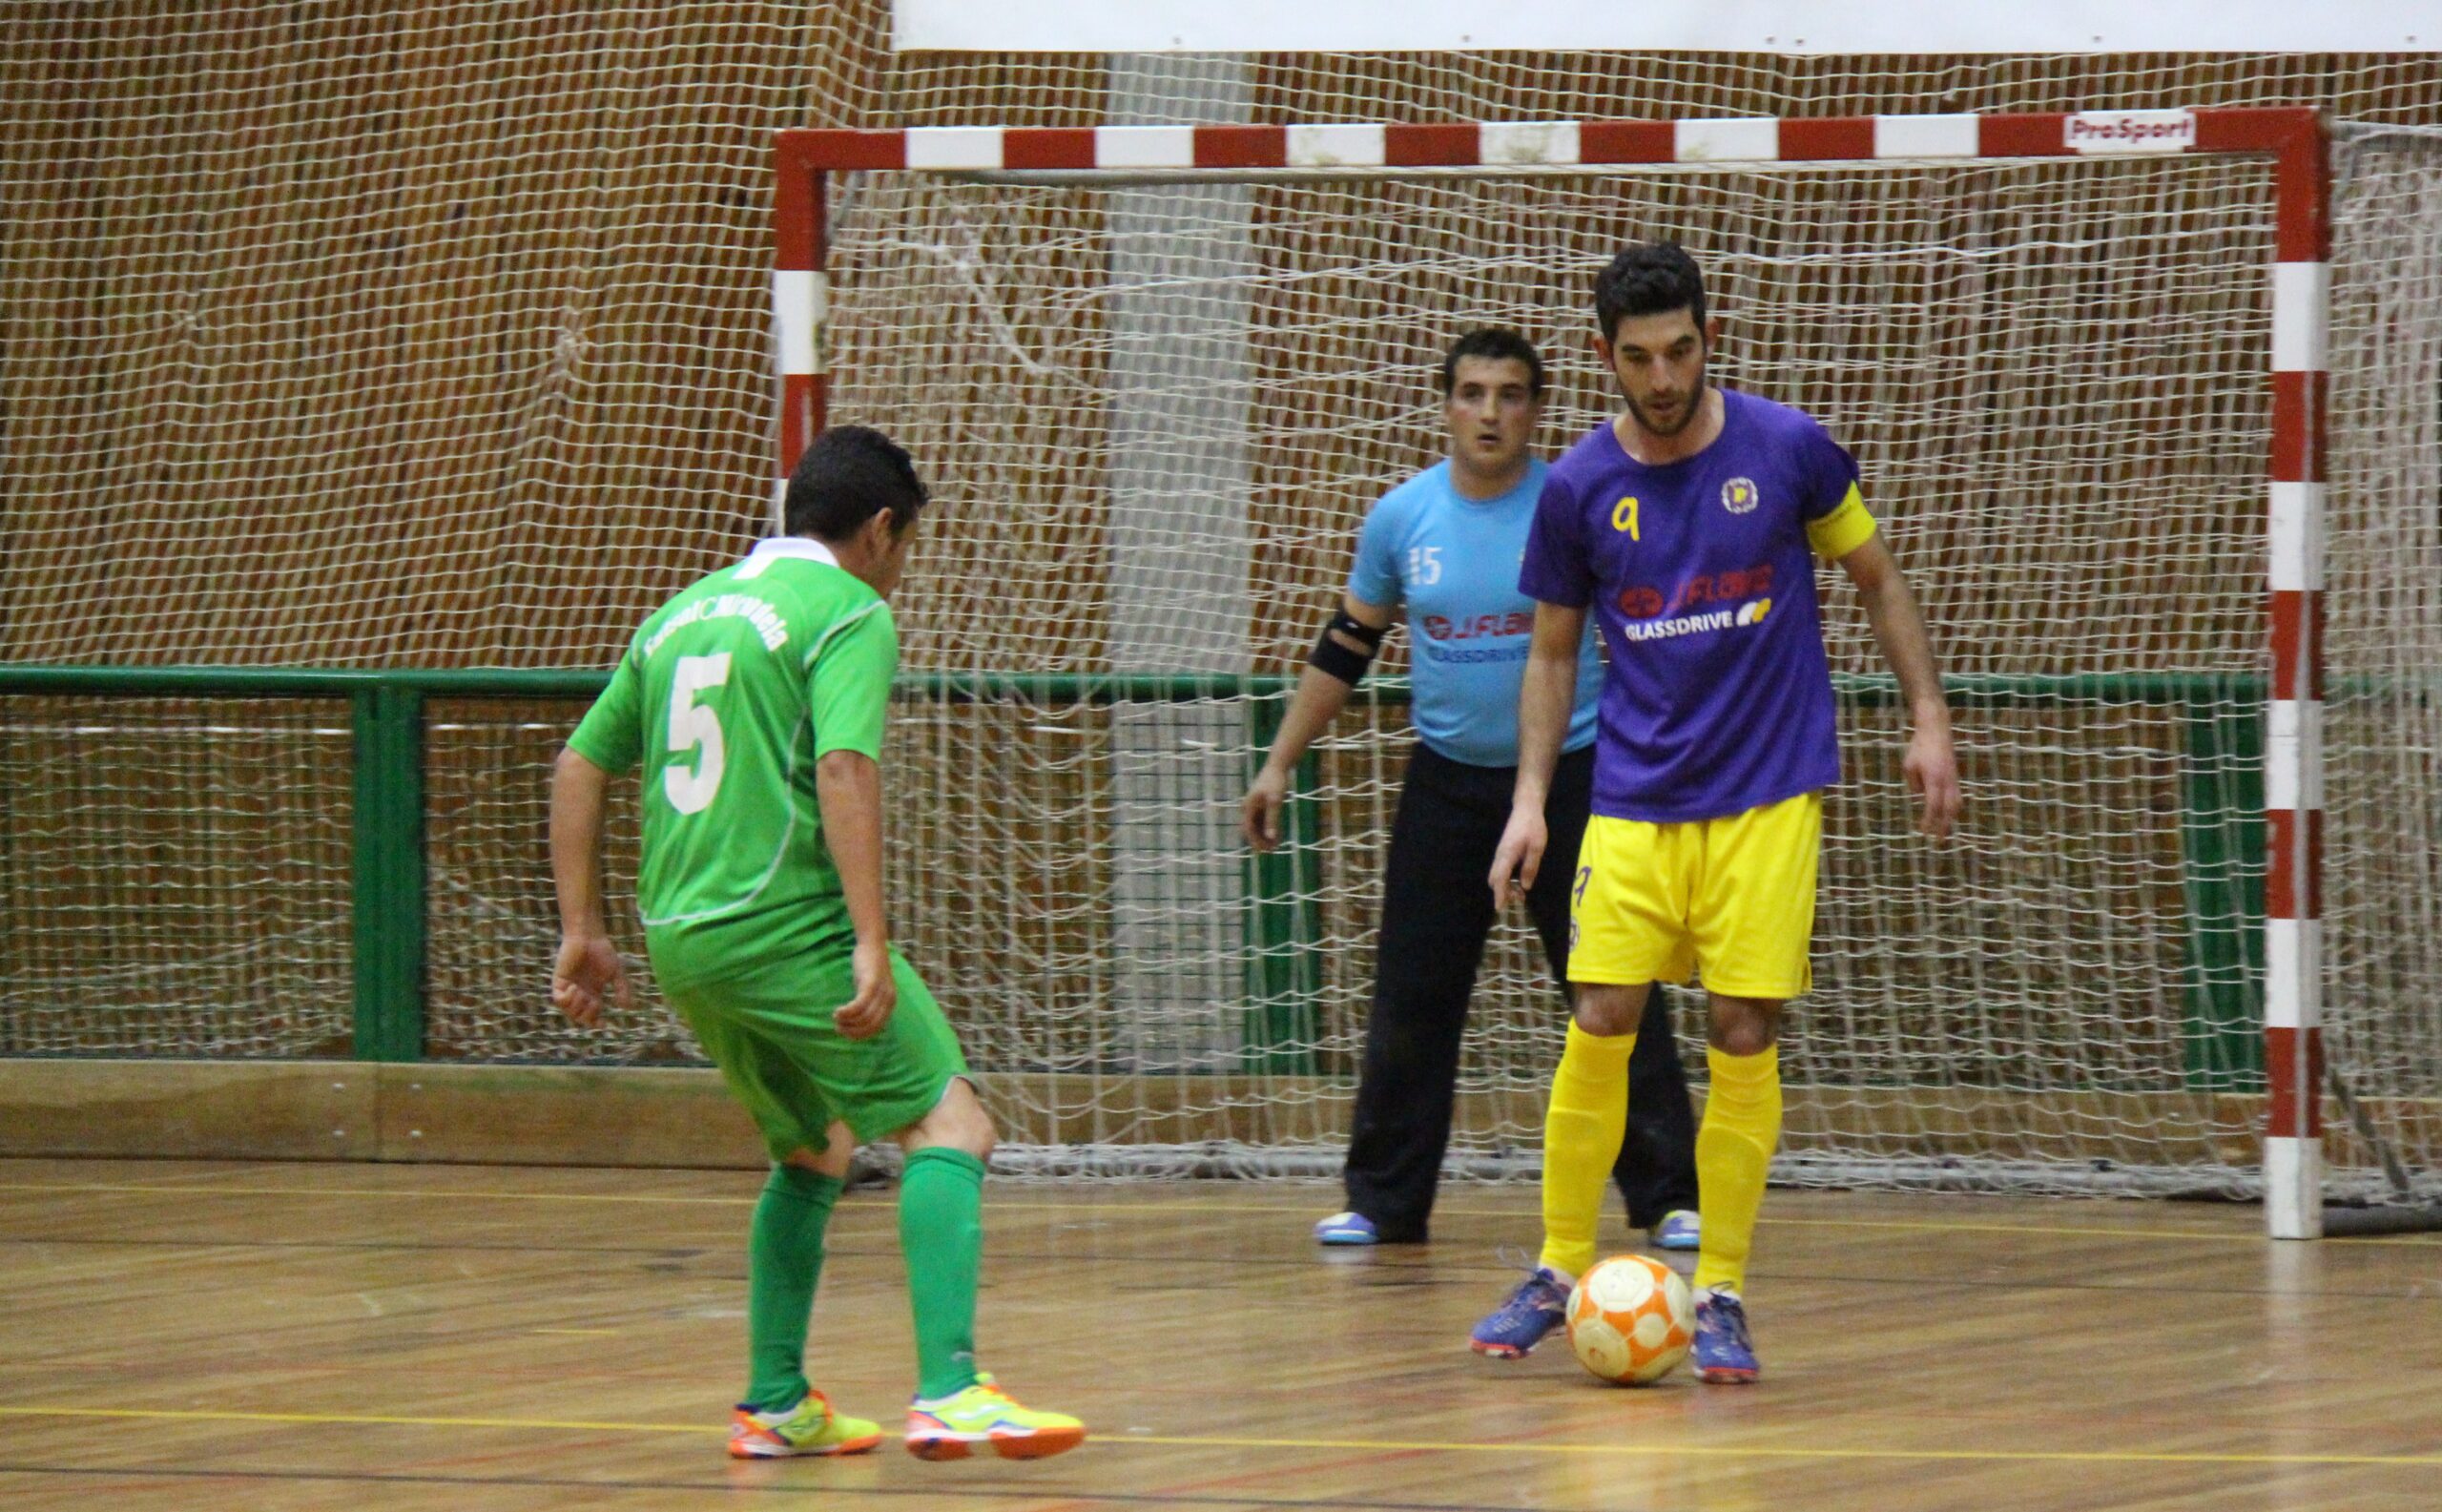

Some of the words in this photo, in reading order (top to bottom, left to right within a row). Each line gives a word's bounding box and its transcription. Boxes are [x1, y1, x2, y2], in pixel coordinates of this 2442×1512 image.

[2072, 117, 2190, 144] ProSport
[1408, 546, 1443, 586] 15
[1625, 610, 1733, 642] GLASSDRIVE
[664, 652, 733, 816] 5
